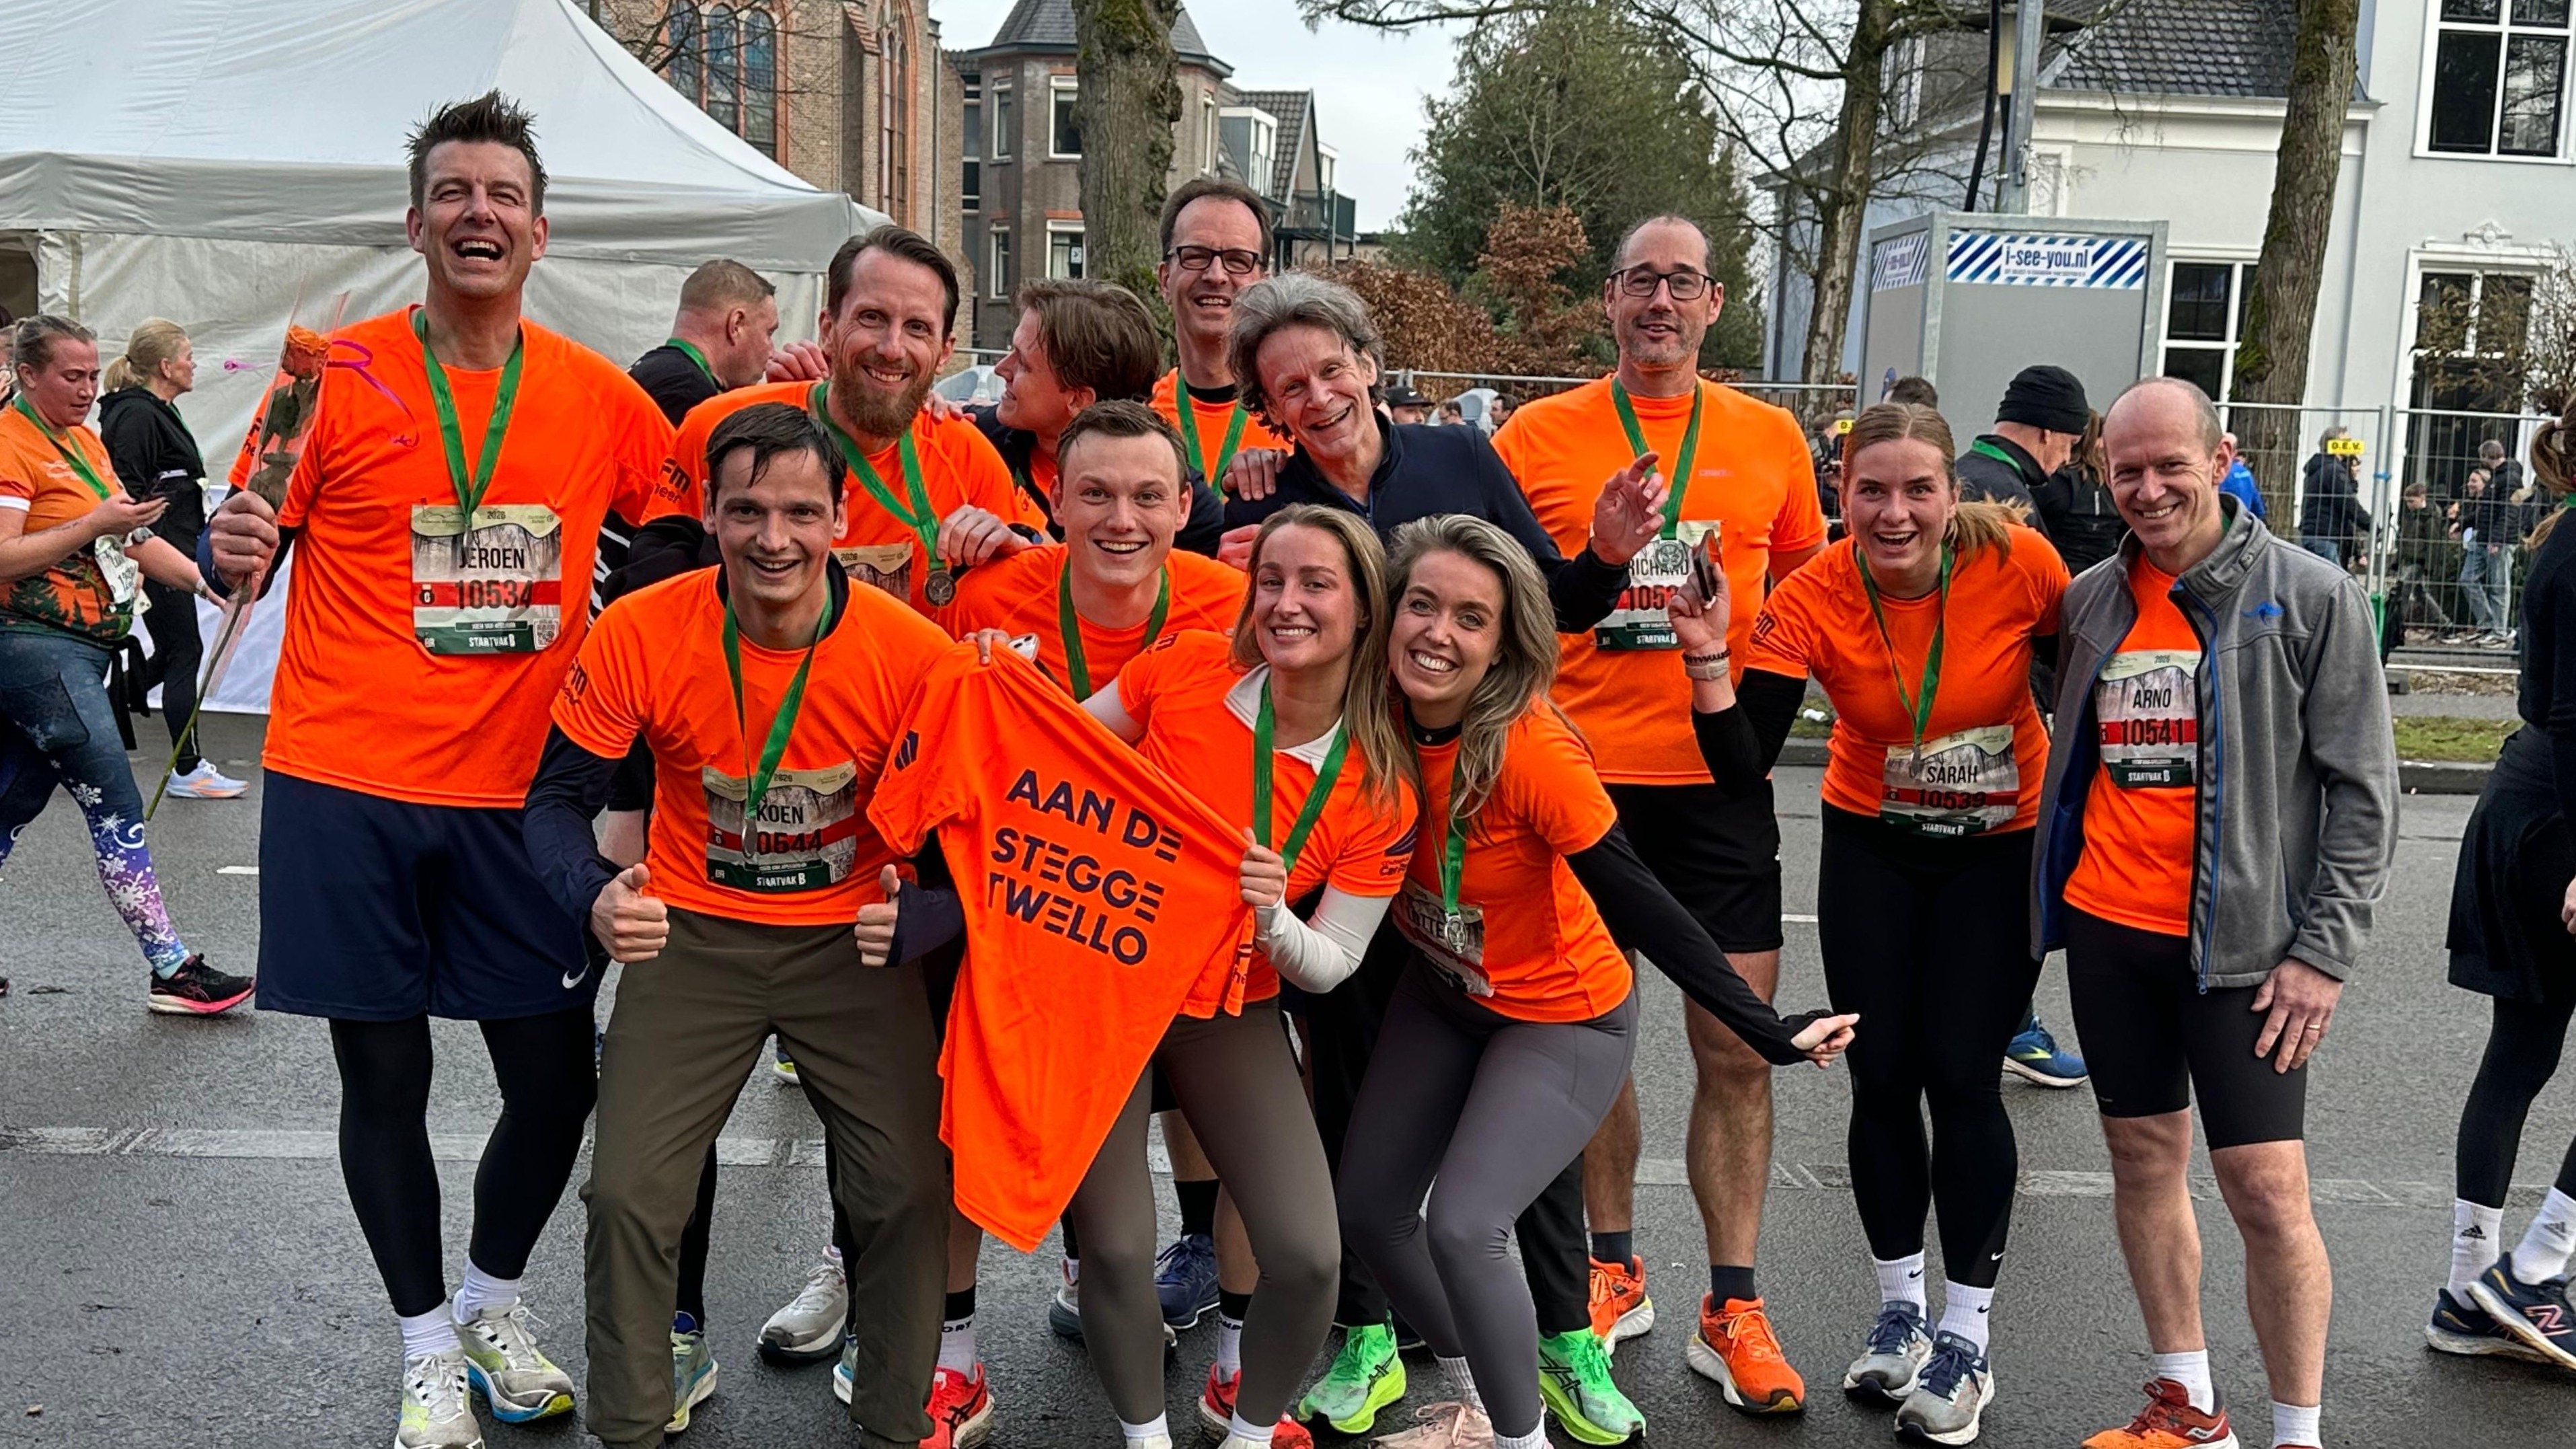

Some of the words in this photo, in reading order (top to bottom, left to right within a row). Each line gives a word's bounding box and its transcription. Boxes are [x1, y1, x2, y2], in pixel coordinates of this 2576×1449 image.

[2006, 246, 2088, 269] i-see-you.nl
[459, 547, 525, 570] JEROEN
[455, 579, 534, 609] 10534
[469, 636, 508, 648] STARTVAK
[1636, 634, 1671, 644] STARTVAK
[2132, 688, 2172, 709] ARNO
[2120, 717, 2184, 747] 10541
[1926, 765, 1979, 784] SARAH
[2127, 772, 2162, 783] STARTVAK
[1918, 788, 1987, 811] 10539
[756, 803, 804, 825] KOEN
[1005, 768, 1115, 835] AAN
[1122, 806, 1184, 864] DE
[1922, 823, 1957, 835] STARTVAK
[756, 875, 798, 887] STARTVAK
[798, 872, 807, 886] B
[990, 827, 1165, 924] STEGGE
[988, 871, 1148, 966] TWELLO
